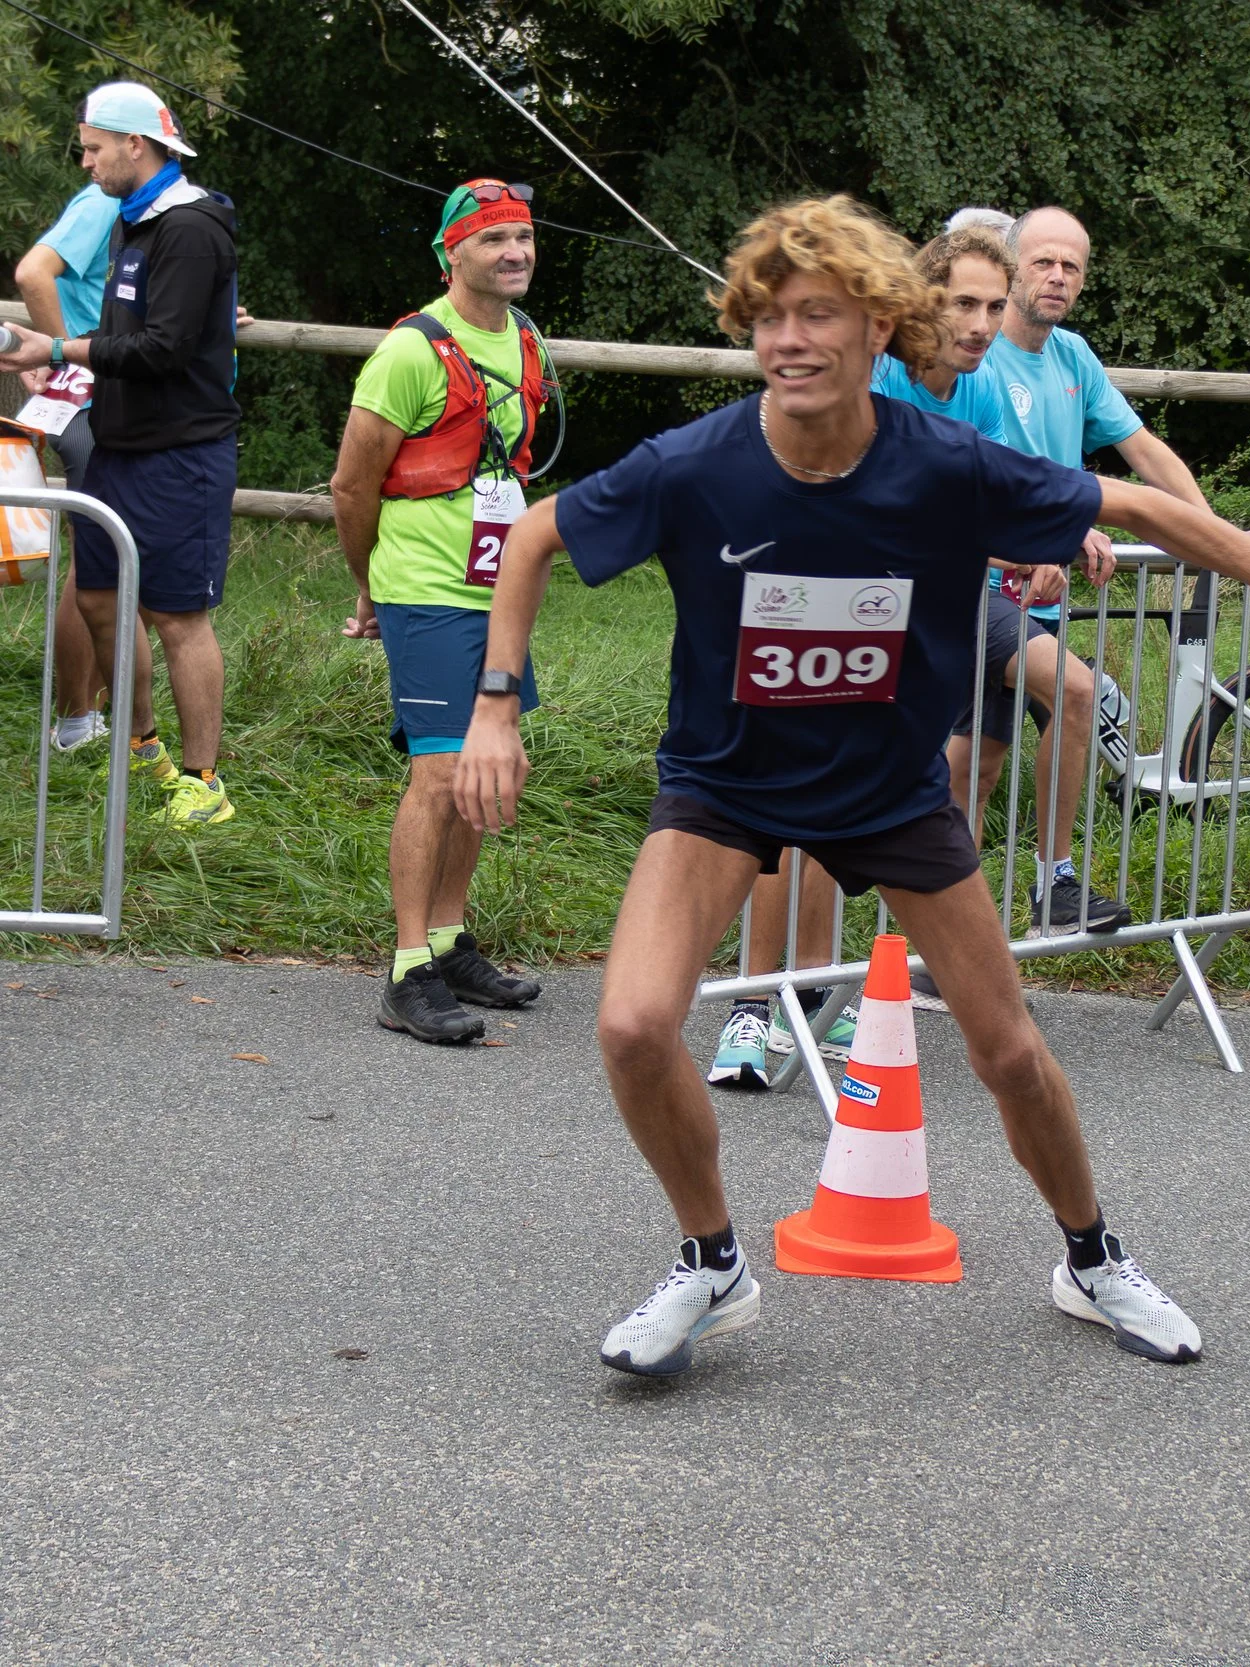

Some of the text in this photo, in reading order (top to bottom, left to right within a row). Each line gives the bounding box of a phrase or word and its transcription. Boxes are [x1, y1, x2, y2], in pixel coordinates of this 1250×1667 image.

[482, 208, 528, 224] PORTUG
[474, 535, 507, 572] 2
[750, 645, 889, 688] 309
